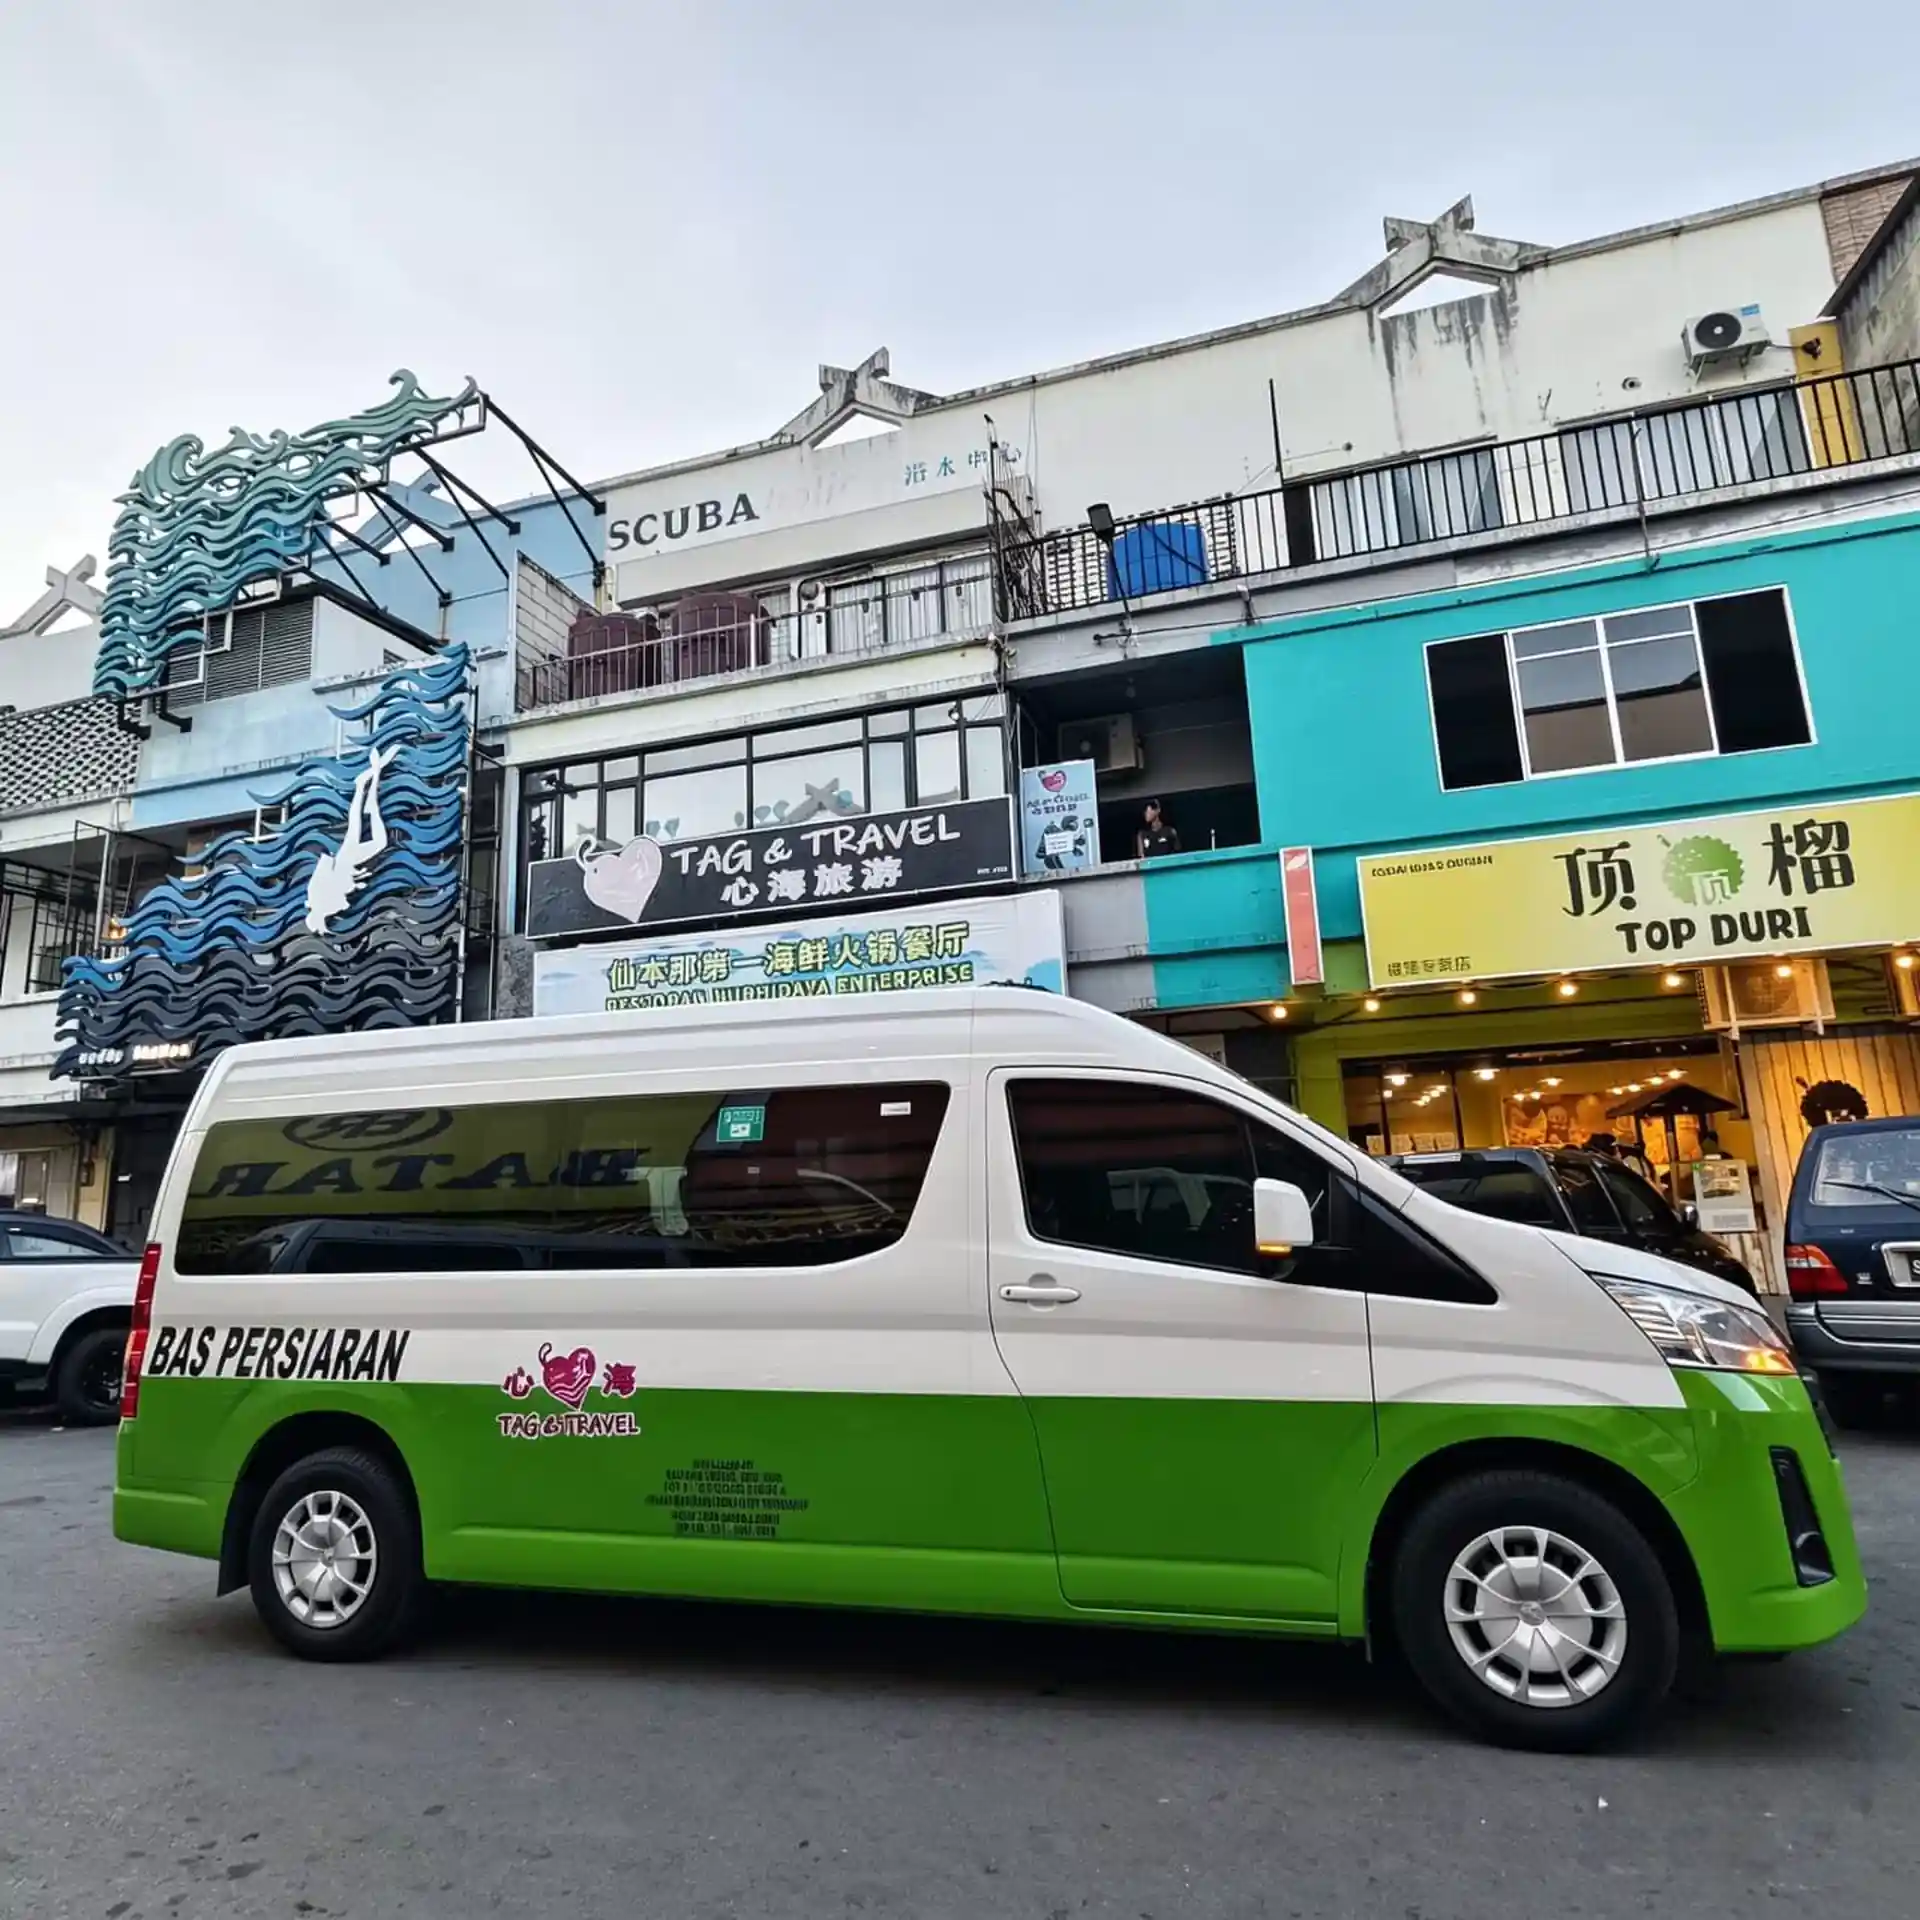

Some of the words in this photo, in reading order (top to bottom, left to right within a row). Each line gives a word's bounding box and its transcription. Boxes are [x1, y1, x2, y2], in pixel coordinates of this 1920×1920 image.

[608, 492, 760, 551] SCUBA
[670, 839, 752, 876] TAG
[763, 838, 793, 865] &
[800, 813, 961, 857] TRAVEL
[1553, 840, 1638, 917] 顶
[1762, 818, 1855, 897] 榴
[720, 855, 904, 907] 心海旅游
[1615, 917, 1697, 953] TOP
[1710, 906, 1813, 946] DURI
[836, 961, 974, 994] ENTERPRISE
[148, 1326, 216, 1376] BAS
[216, 1326, 411, 1381] PERSIARAN
[497, 1411, 540, 1439] TAG
[562, 1411, 640, 1438] TRAVEL
